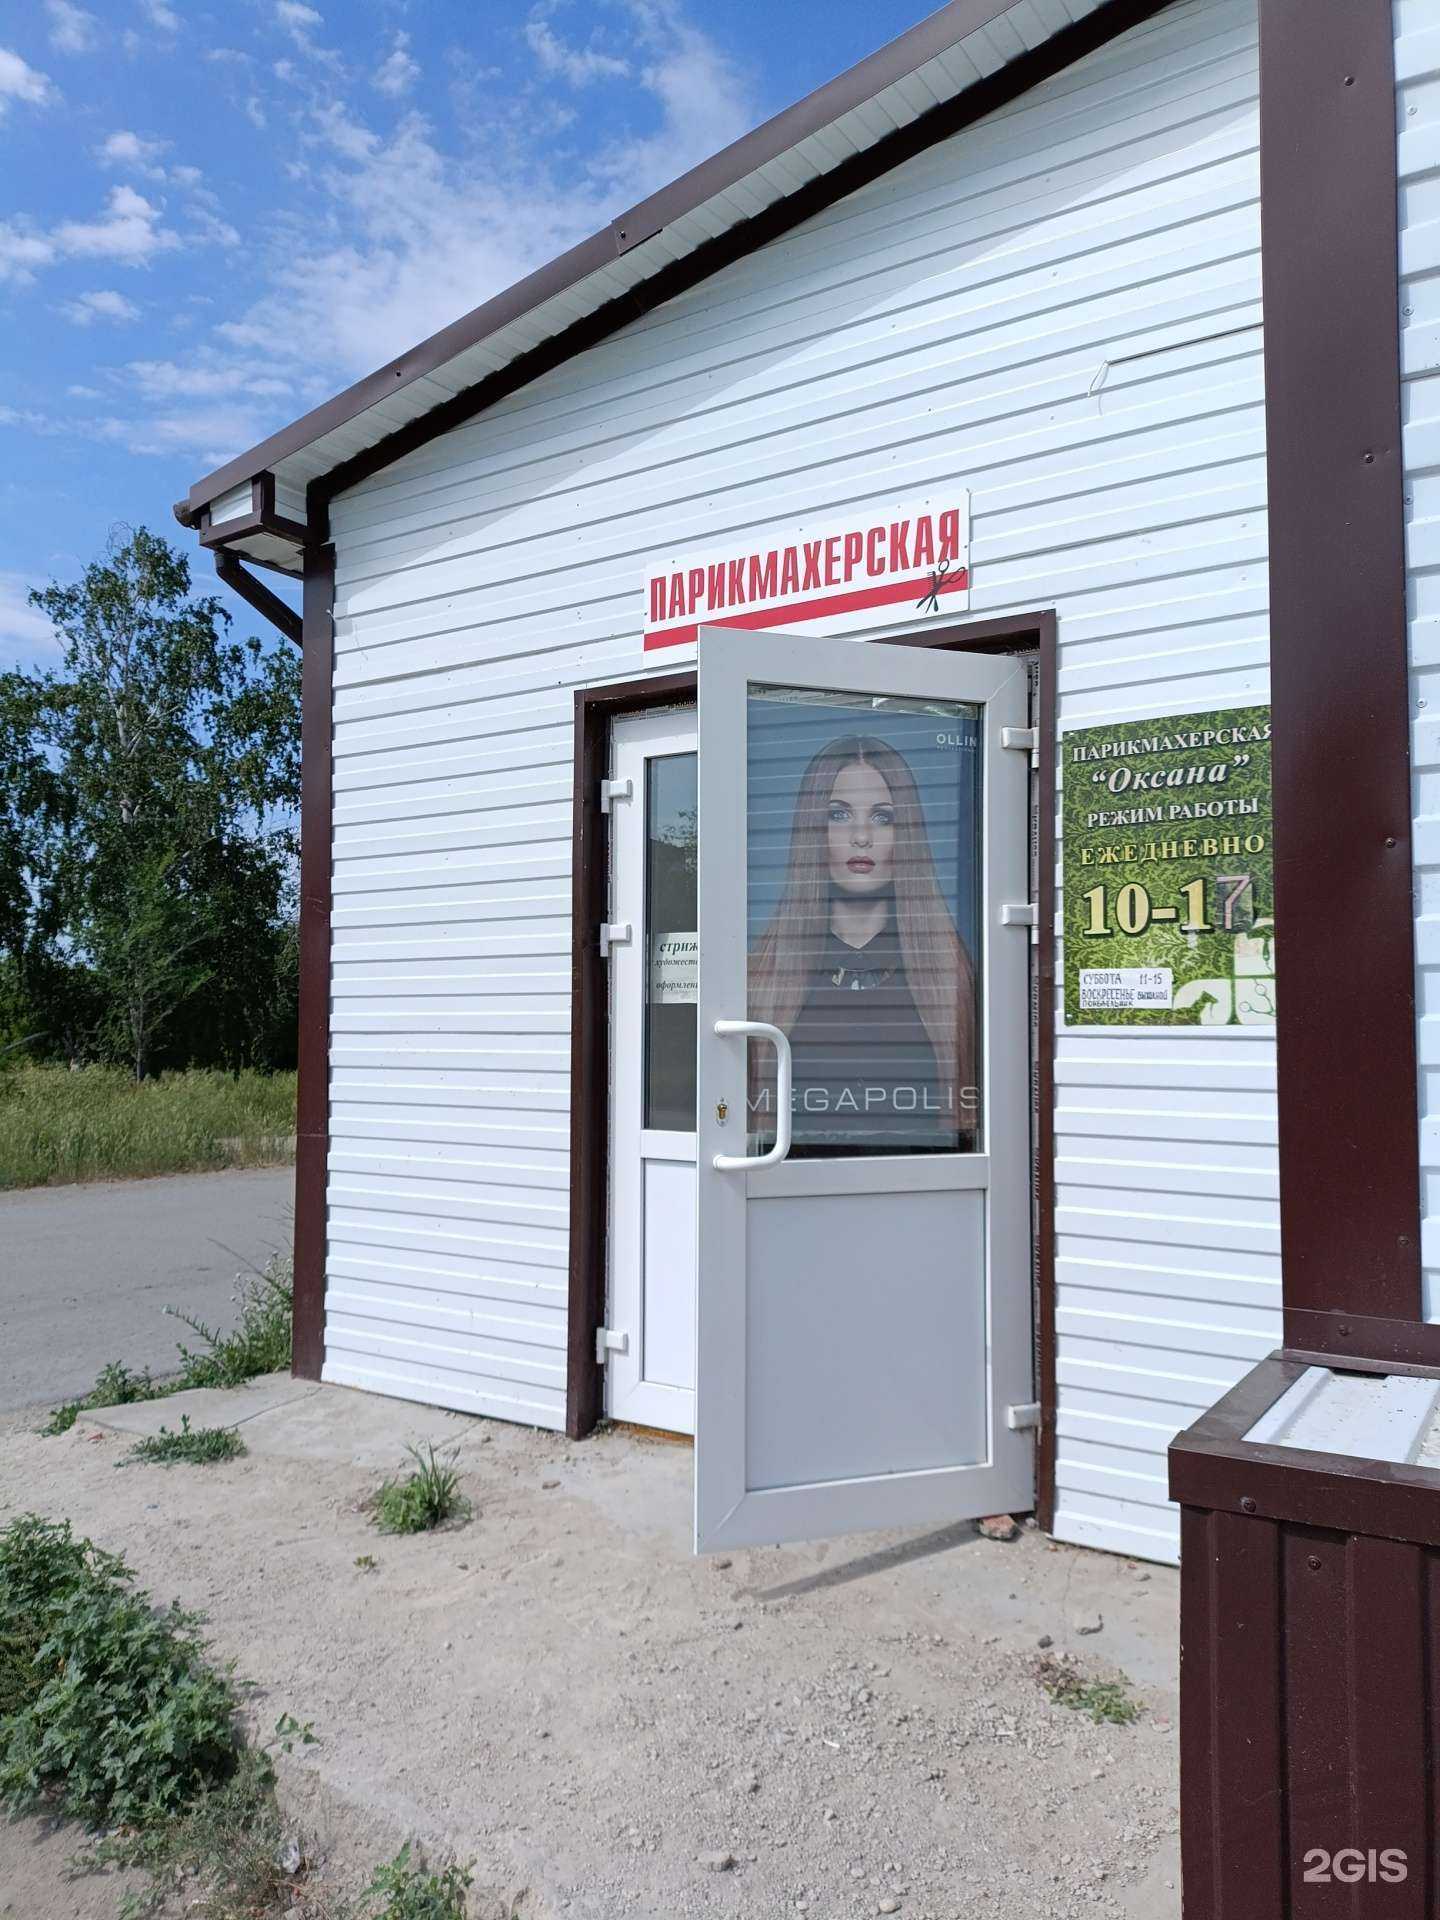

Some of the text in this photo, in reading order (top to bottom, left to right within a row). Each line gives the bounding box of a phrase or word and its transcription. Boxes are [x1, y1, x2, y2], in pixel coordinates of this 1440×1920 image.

[650, 508, 960, 623] ПАРИКМАХЕРСКАЯ
[936, 734, 977, 747] OLLIN
[1073, 723, 1272, 762] ПАРИКМАХЕРСКАЯ
[1087, 798, 1259, 828] РЕЖИМ РАБОТЫ
[1081, 834, 1265, 865] ЕЖЕДНЕВНО
[1082, 874, 1251, 936] 10-17
[1083, 972, 1163, 985] СУББОТА 11-15
